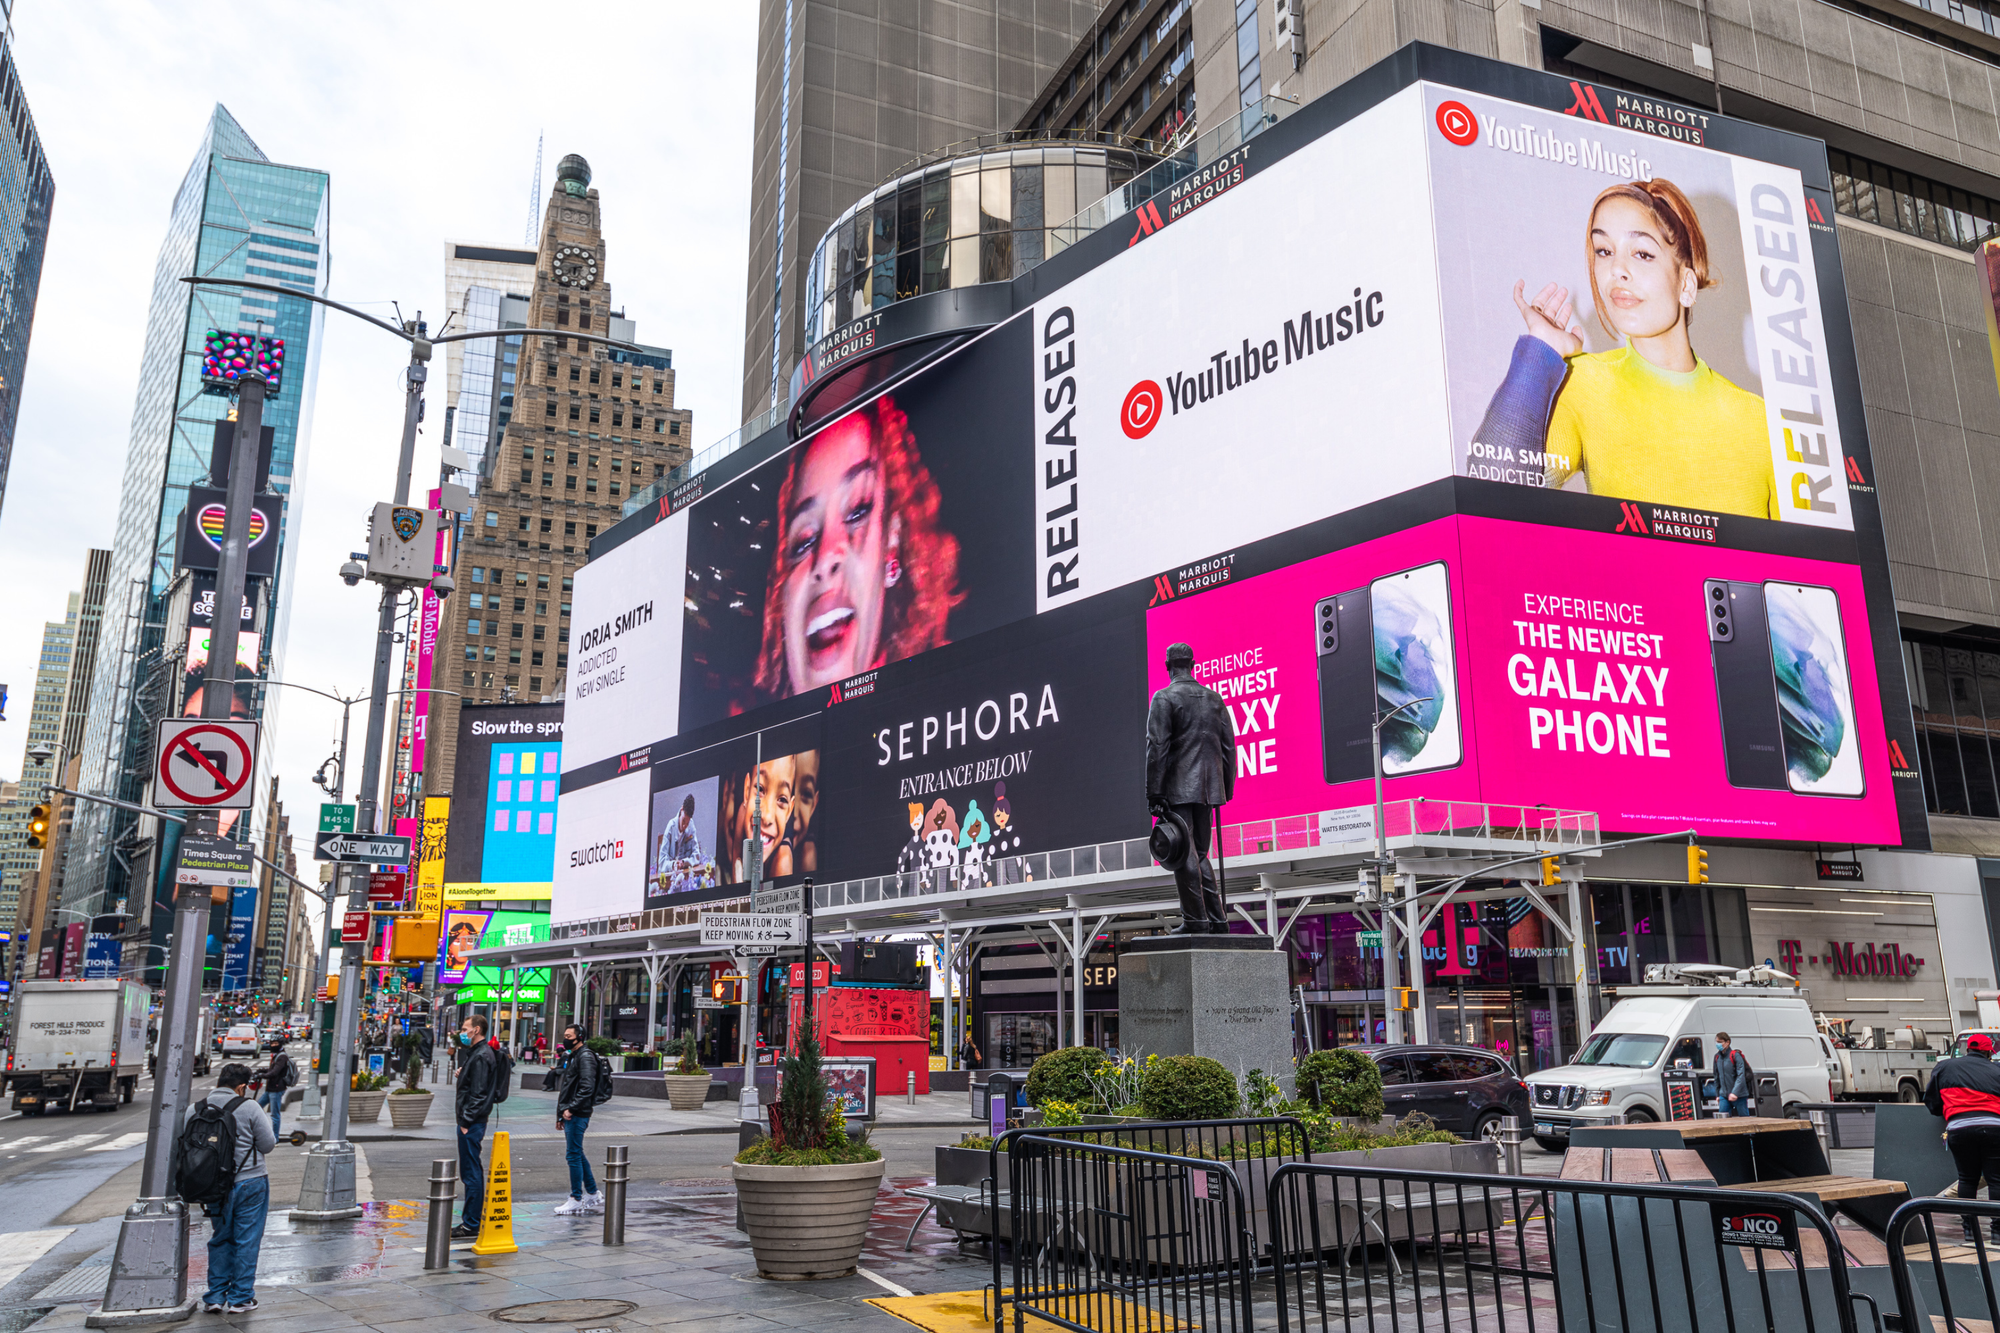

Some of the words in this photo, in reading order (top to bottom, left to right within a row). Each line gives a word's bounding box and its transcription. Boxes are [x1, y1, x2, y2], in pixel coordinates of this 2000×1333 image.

[1617, 95, 1710, 130] MARRIOTT
[1618, 112, 1701, 144] MARQUIS
[1480, 112, 1578, 167] YouTube
[1580, 138, 1653, 184] Music
[1170, 145, 1250, 202] MARRIOTT
[1171, 168, 1242, 219] MARQUIS
[1810, 222, 1834, 234] ARRIOTT
[820, 313, 882, 355] MARRIOTT
[818, 334, 872, 372] MARQUIS
[1166, 338, 1278, 416] YouTube
[1284, 287, 1384, 366] Music
[1750, 183, 1837, 514] RELEASED
[1044, 306, 1080, 598] RELEASED
[1466, 441, 1514, 462] JORJA
[1518, 448, 1570, 471] SMITH
[674, 473, 706, 498] MARRIOTT
[1468, 464, 1546, 488] ADDICTED
[1849, 484, 1874, 493] ARRIOTT
[672, 486, 702, 510] MARQUIS
[1653, 508, 1720, 528] MARRIOTT
[1654, 522, 1714, 541] MARQUIS
[1179, 554, 1236, 580] MARRIOTT
[1180, 568, 1230, 594] MARQUIS
[1524, 593, 1644, 625] EXPERIENCE
[578, 622, 612, 654] JORJA
[614, 600, 653, 637] SMITH
[1513, 620, 1562, 650] THE
[1568, 626, 1664, 659] NEWEST
[577, 646, 618, 677] ADDICTED
[1193, 647, 1264, 680] PERIENCE
[576, 678, 594, 700] NEW
[596, 666, 626, 692] SINGLE
[844, 683, 874, 700] MARQUIS
[845, 672, 878, 689] MARRIOTT
[1508, 653, 1670, 706] GALAXY
[472, 722, 508, 734] Slow
[510, 720, 538, 733] the
[878, 684, 1060, 766] SEPHORA
[1528, 707, 1670, 758] PHONE
[899, 764, 974, 800] ENTRANCE
[974, 750, 1032, 784] BELOW
[1892, 770, 1918, 778] ARRIOTT
[1322, 826, 1338, 834] WATTS
[1339, 822, 1372, 831] RESTORATION
[183, 849, 209, 858] Times
[211, 851, 242, 860] Square
[330, 842, 357, 853] ONE
[370, 844, 398, 855] WAY
[570, 840, 614, 868] swatch
[182, 858, 226, 868] Pedestrian
[227, 862, 249, 870] Plaza
[418, 902, 439, 912] KING
[756, 894, 778, 906] PEDESTRIAN
[779, 892, 789, 901] FLOW
[790, 890, 800, 899] ZONE
[775, 904, 785, 914] KEEP
[785, 902, 800, 912] MOVING
[706, 917, 750, 927] PEDESTRIAN
[753, 918, 771, 927] FLOW
[774, 918, 792, 927] ZONE
[706, 931, 724, 940] KEEP
[726, 931, 753, 940] MOVING
[517, 990, 540, 998] ORK
[1534, 1011, 1551, 1022] FRE
